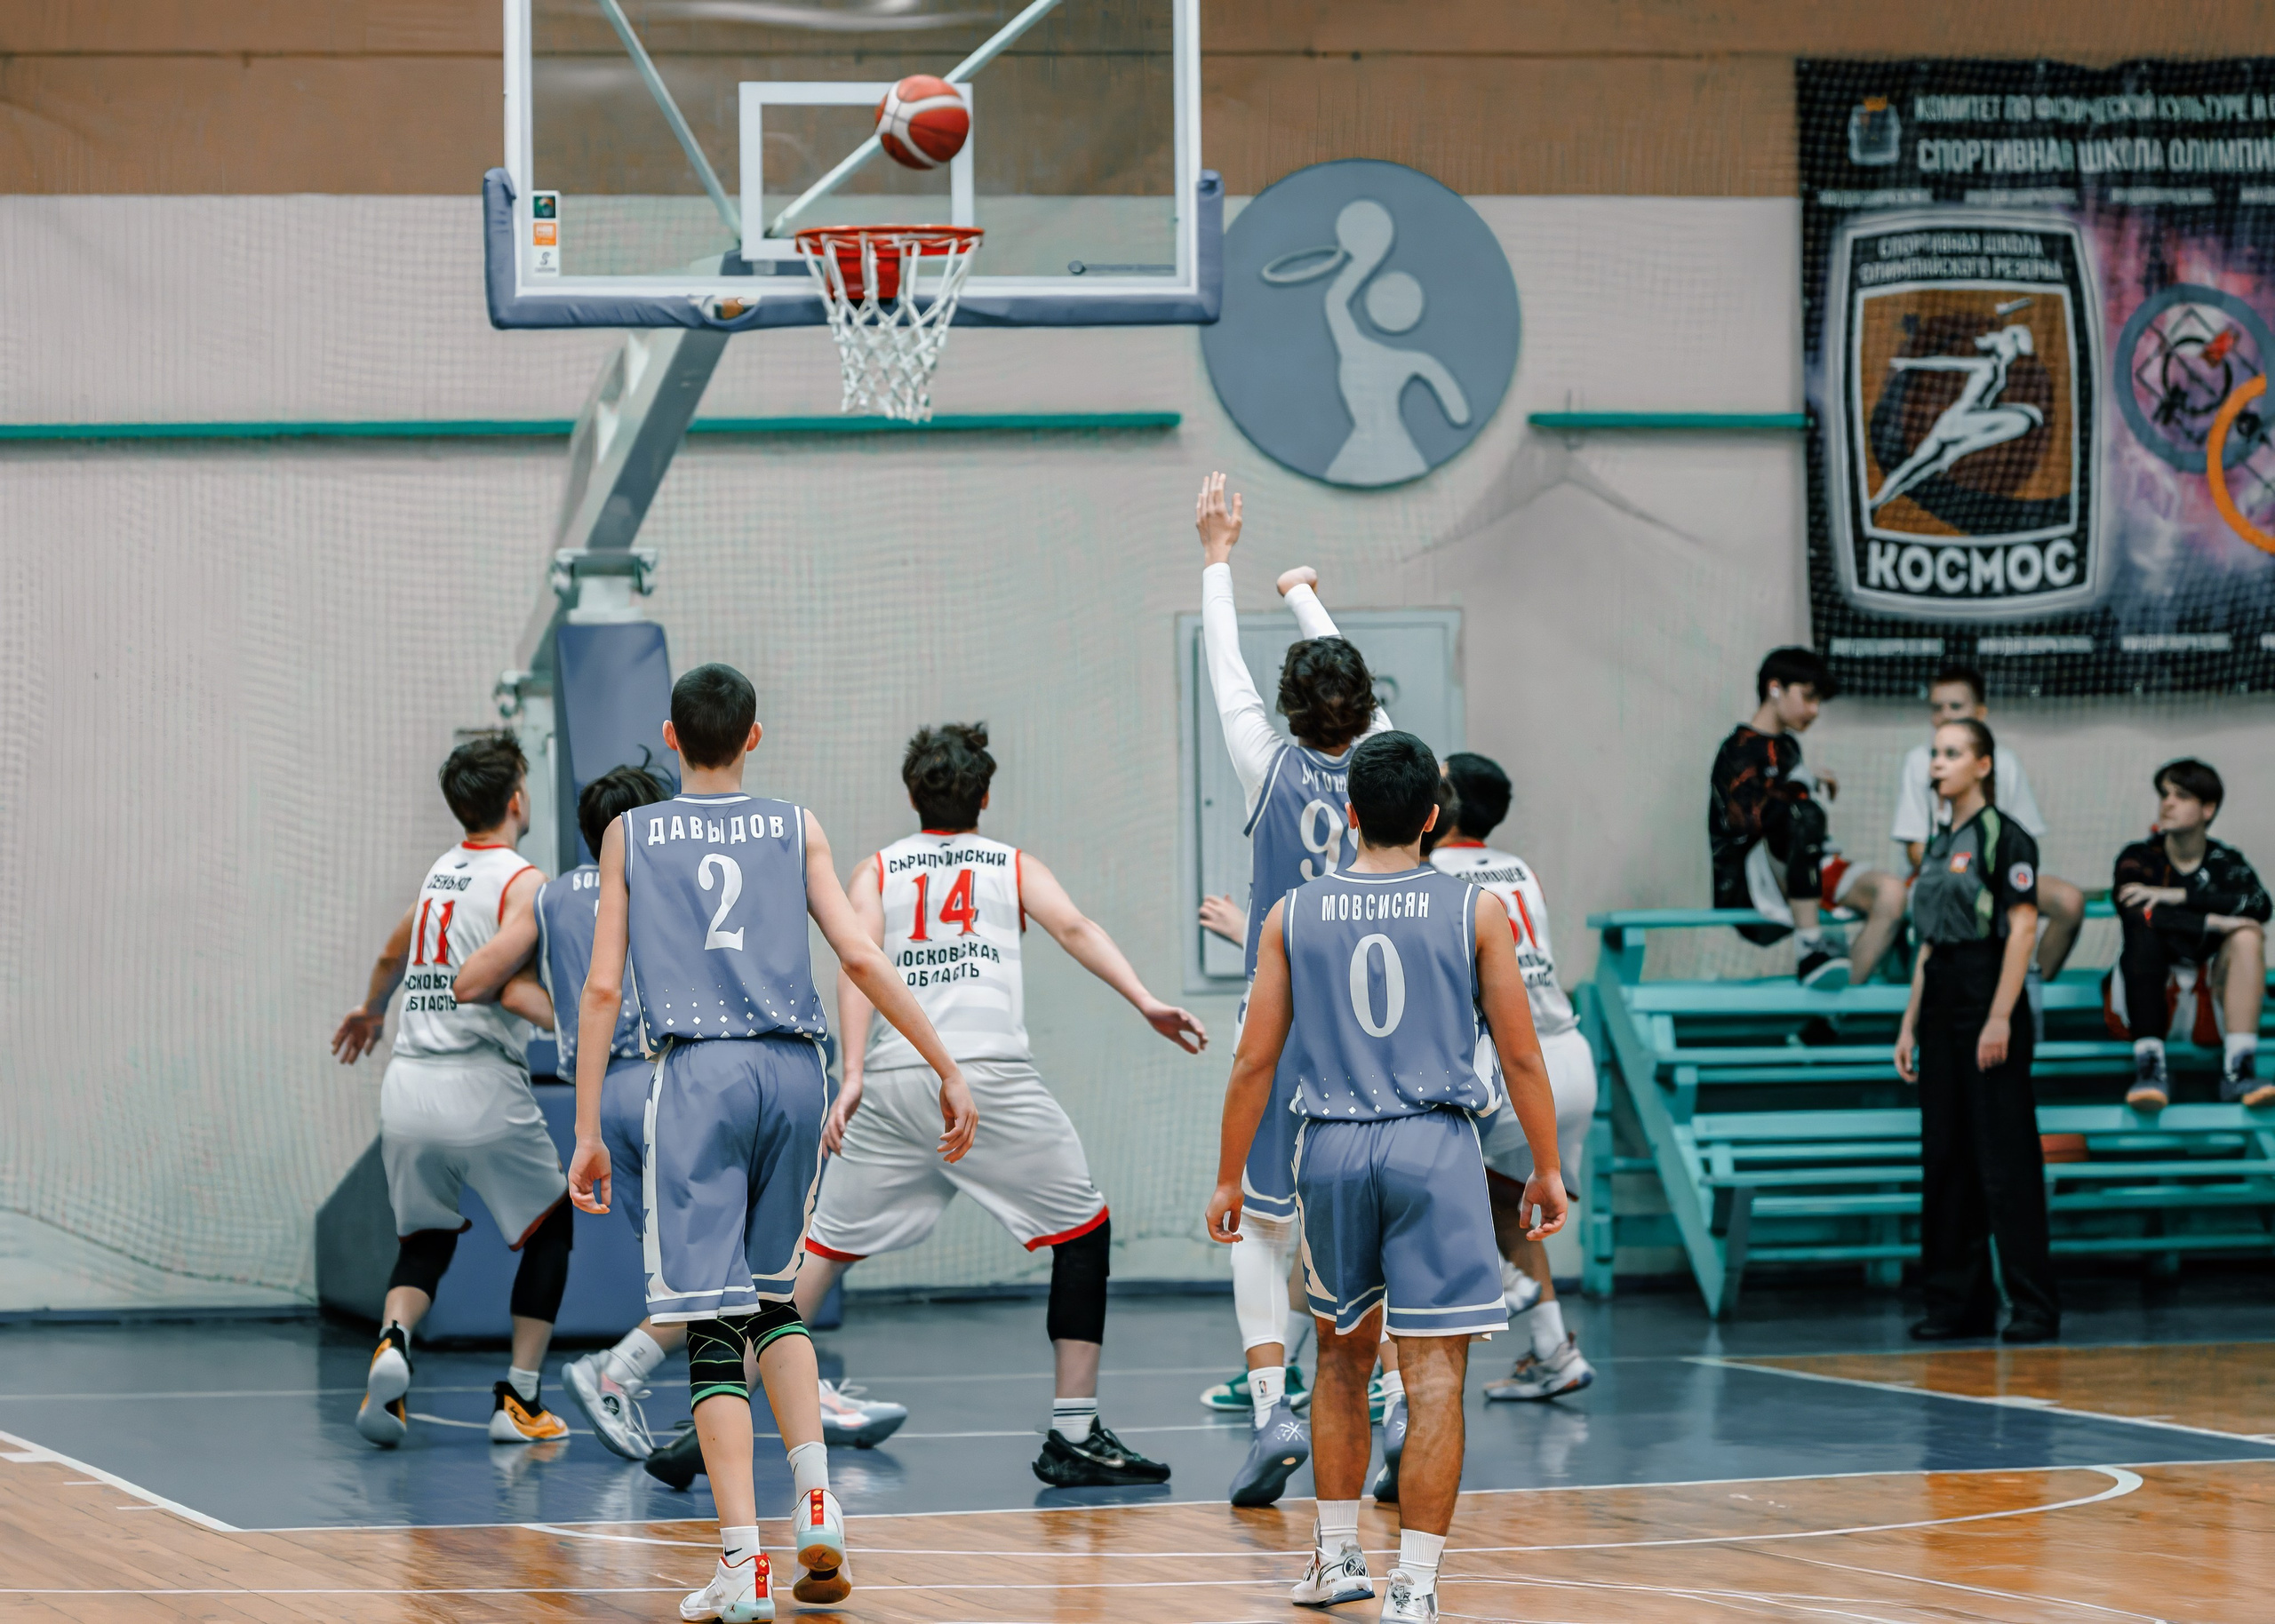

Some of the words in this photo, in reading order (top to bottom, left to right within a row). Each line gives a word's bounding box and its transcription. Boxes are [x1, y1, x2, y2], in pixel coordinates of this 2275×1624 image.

[2076, 136, 2166, 174] ШКОЛА
[1867, 537, 2077, 593] КОСМОС
[647, 814, 785, 847] ДАВЫДОВ
[698, 853, 745, 951] 2
[906, 869, 980, 943] 14
[1321, 892, 1430, 921] МОВСИСЯН
[412, 897, 456, 967] 11
[906, 963, 980, 987] ОБЛАСТЬ
[1349, 933, 1406, 1038] 0
